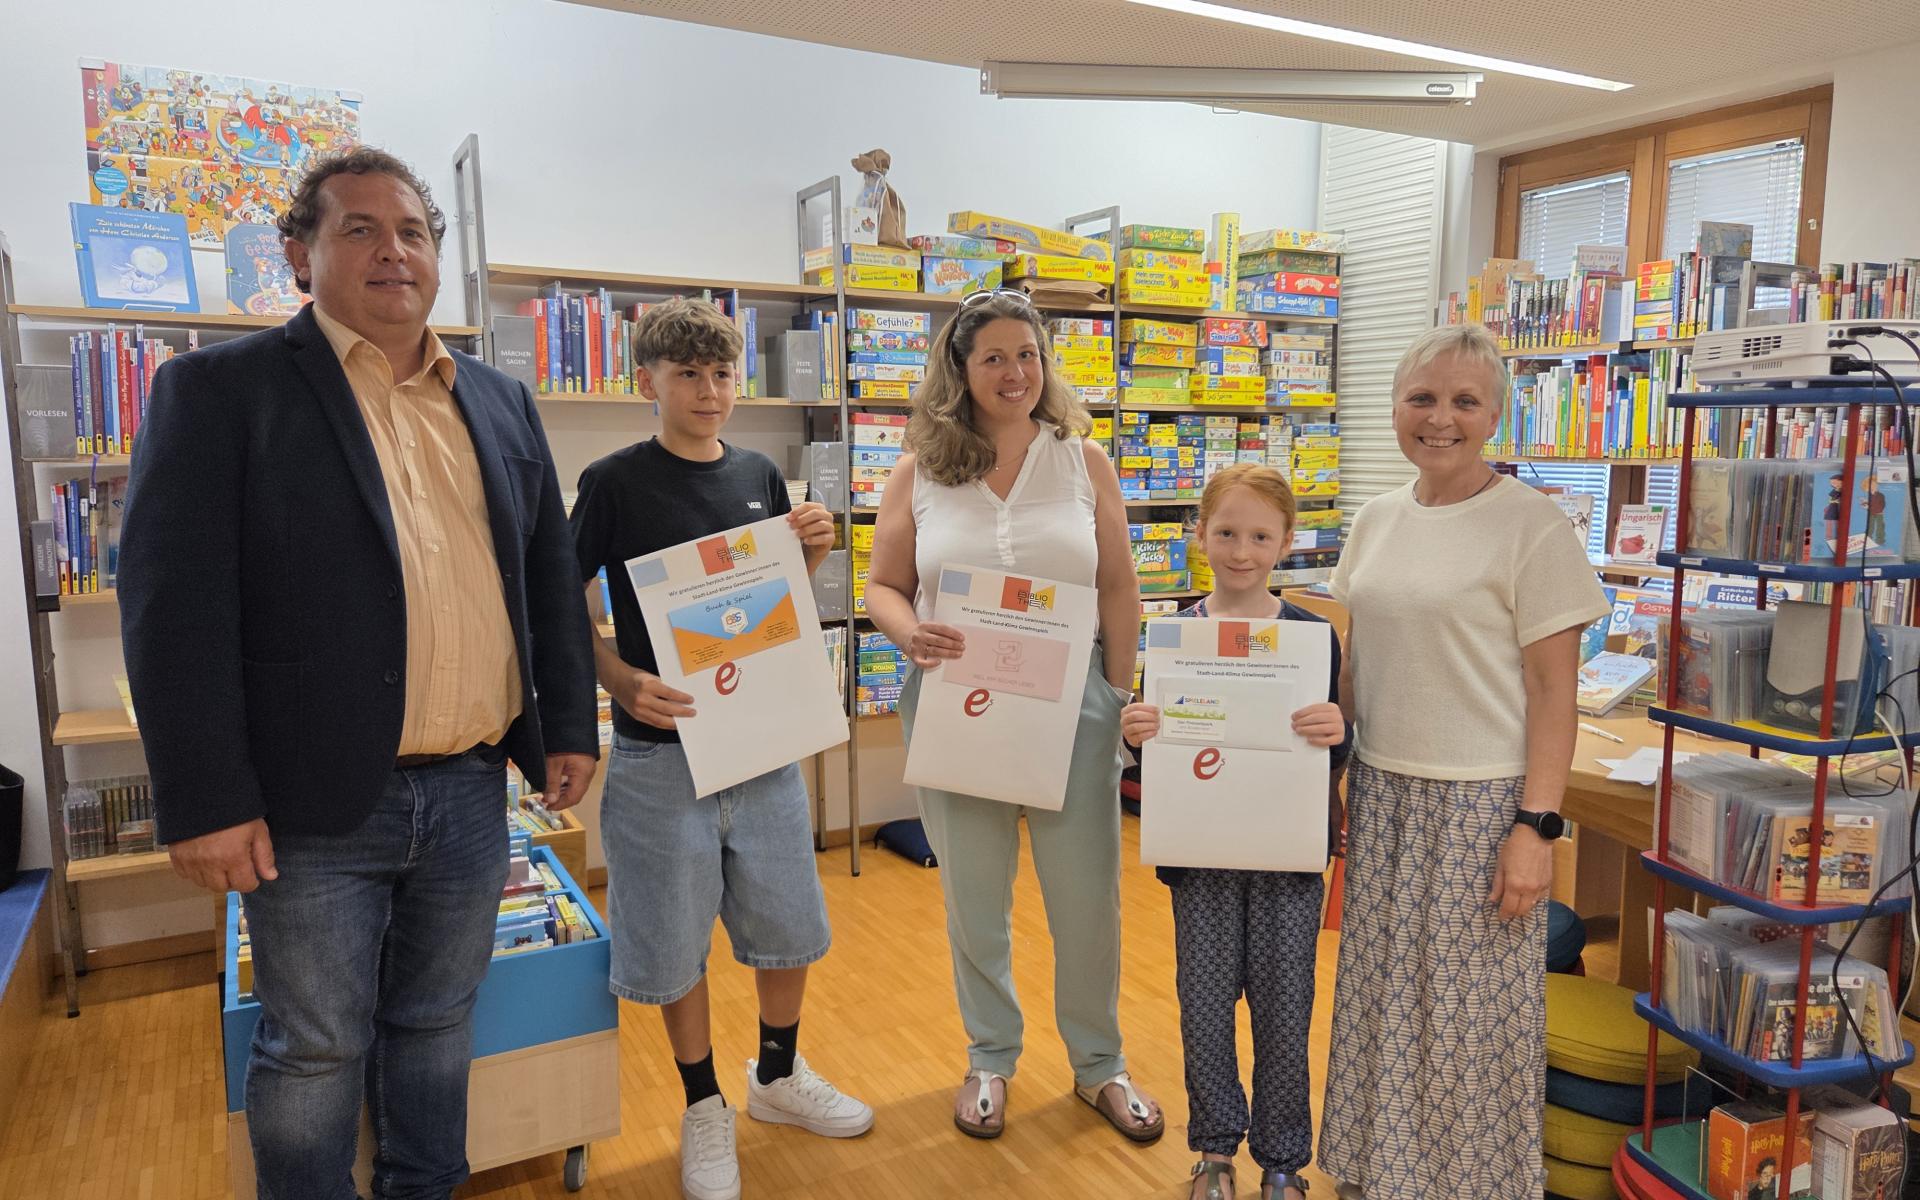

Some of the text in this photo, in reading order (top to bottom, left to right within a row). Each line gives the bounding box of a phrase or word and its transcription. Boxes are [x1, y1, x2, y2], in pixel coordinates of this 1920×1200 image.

[1223, 222, 1234, 290] Bienenquiz
[876, 318, 914, 331] Gefühle?
[505, 358, 528, 366] SAGEN
[26, 409, 68, 417] VORLESEN
[1621, 513, 1663, 522] Ungarisch
[678, 583, 706, 596] gratulieren
[706, 577, 725, 588] herzlich
[692, 575, 764, 600] Stadt-Land-Klima Gewinnspiels
[705, 602, 723, 613] Buch
[734, 592, 753, 605] Spiel
[1717, 591, 1756, 603] Ritter
[970, 608, 996, 617] gratulieren
[996, 611, 1014, 620] herzlich
[979, 618, 1048, 634] Stadt-Land-Klima Gewinnspiels
[1241, 671, 1276, 679] Gewinnspiels
[1750, 1133, 1785, 1154] Harry Pott
[1858, 1151, 1901, 1171] Harry Potter
